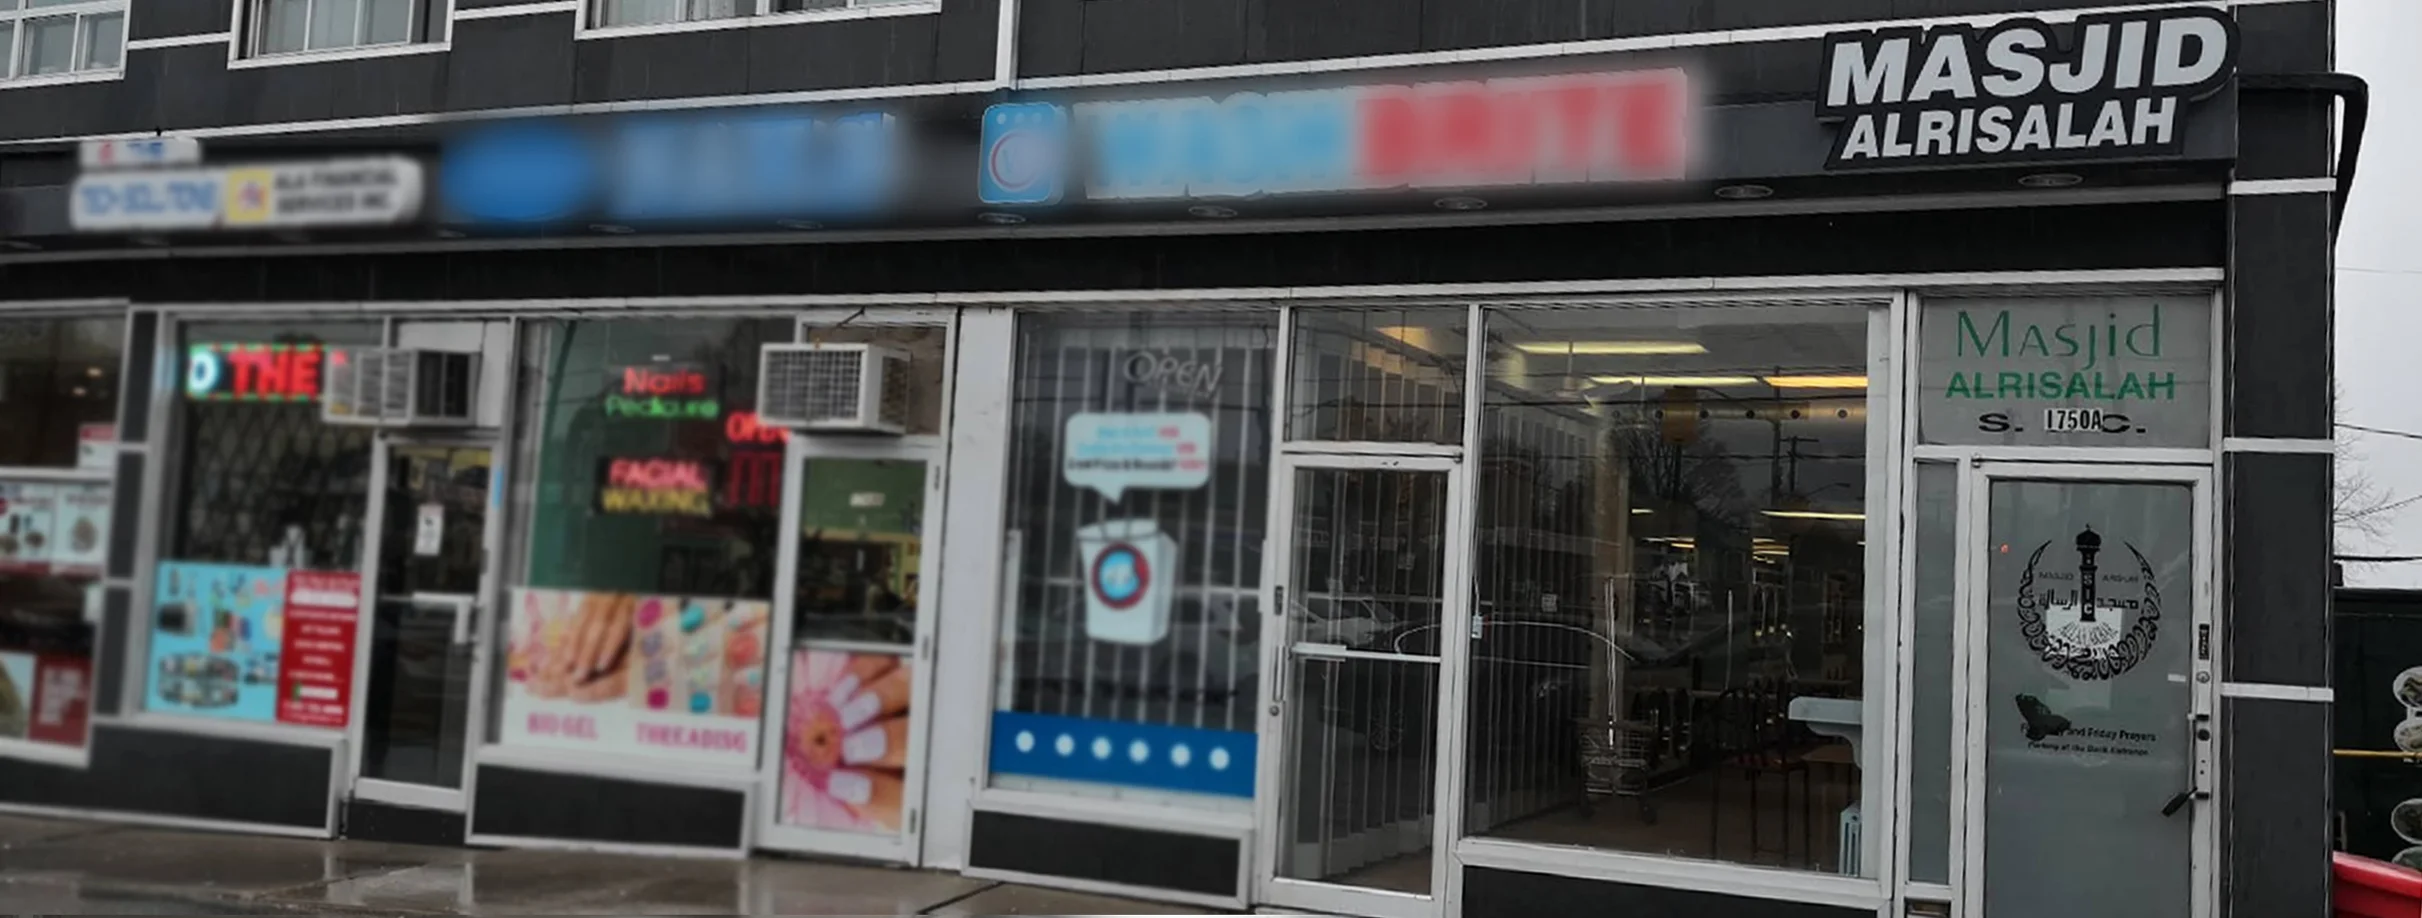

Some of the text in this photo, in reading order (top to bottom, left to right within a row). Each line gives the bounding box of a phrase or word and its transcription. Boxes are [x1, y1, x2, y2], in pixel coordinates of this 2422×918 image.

[1827, 17, 2228, 107] MASJID
[1841, 97, 2177, 160] ALRISALAH
[624, 366, 707, 394] Nails
[1124, 351, 1223, 395] OPEN
[1945, 371, 2175, 400] ALRISALAH
[1978, 413, 2024, 432] S.
[2047, 409, 2101, 430] 1750A
[609, 459, 709, 491] FACIAL
[603, 487, 713, 517] WAXING
[2087, 727, 2117, 740] Friday
[2119, 729, 2156, 743] Prayers
